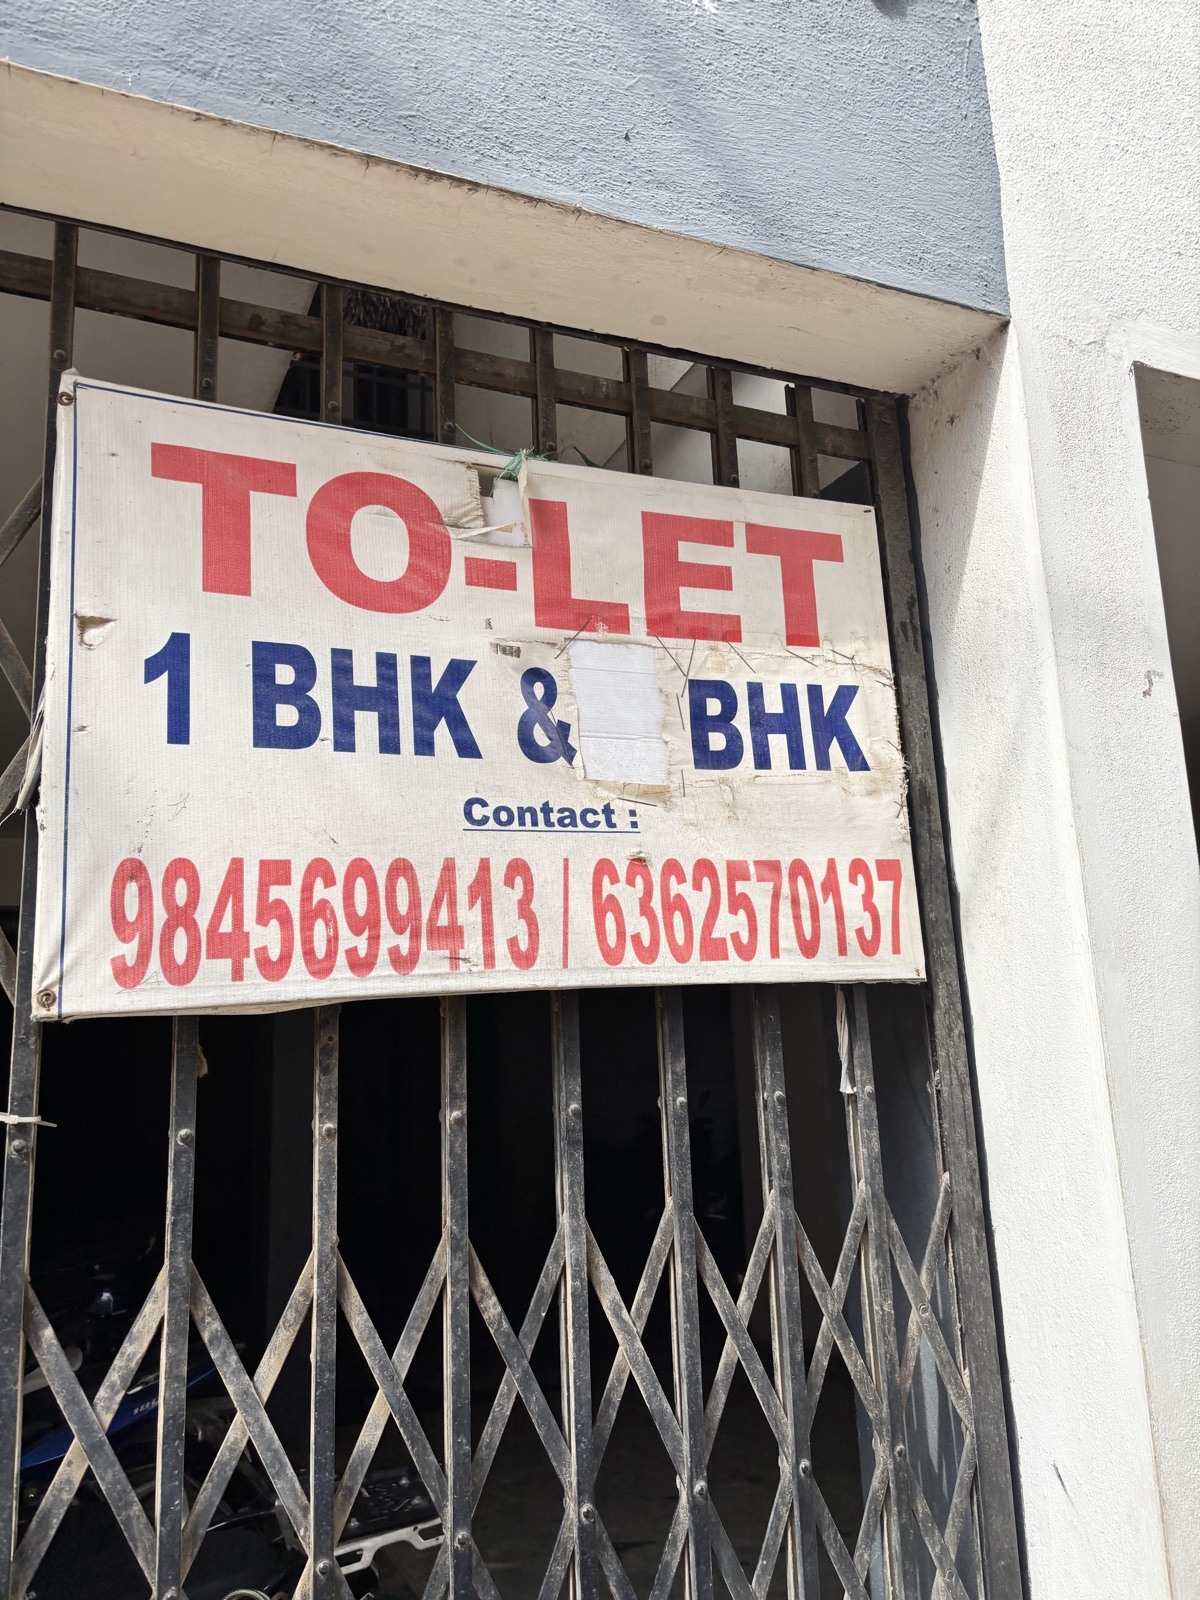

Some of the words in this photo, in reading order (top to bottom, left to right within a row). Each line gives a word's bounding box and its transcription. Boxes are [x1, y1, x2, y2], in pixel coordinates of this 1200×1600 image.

[150, 441, 845, 648] TO-LET
[143, 631, 191, 746] 1
[251, 639, 484, 760] BHK
[517, 666, 578, 765] &
[687, 678, 872, 773] BHK
[109, 856, 541, 990] 9845699413
[591, 856, 903, 967] 6362570137
